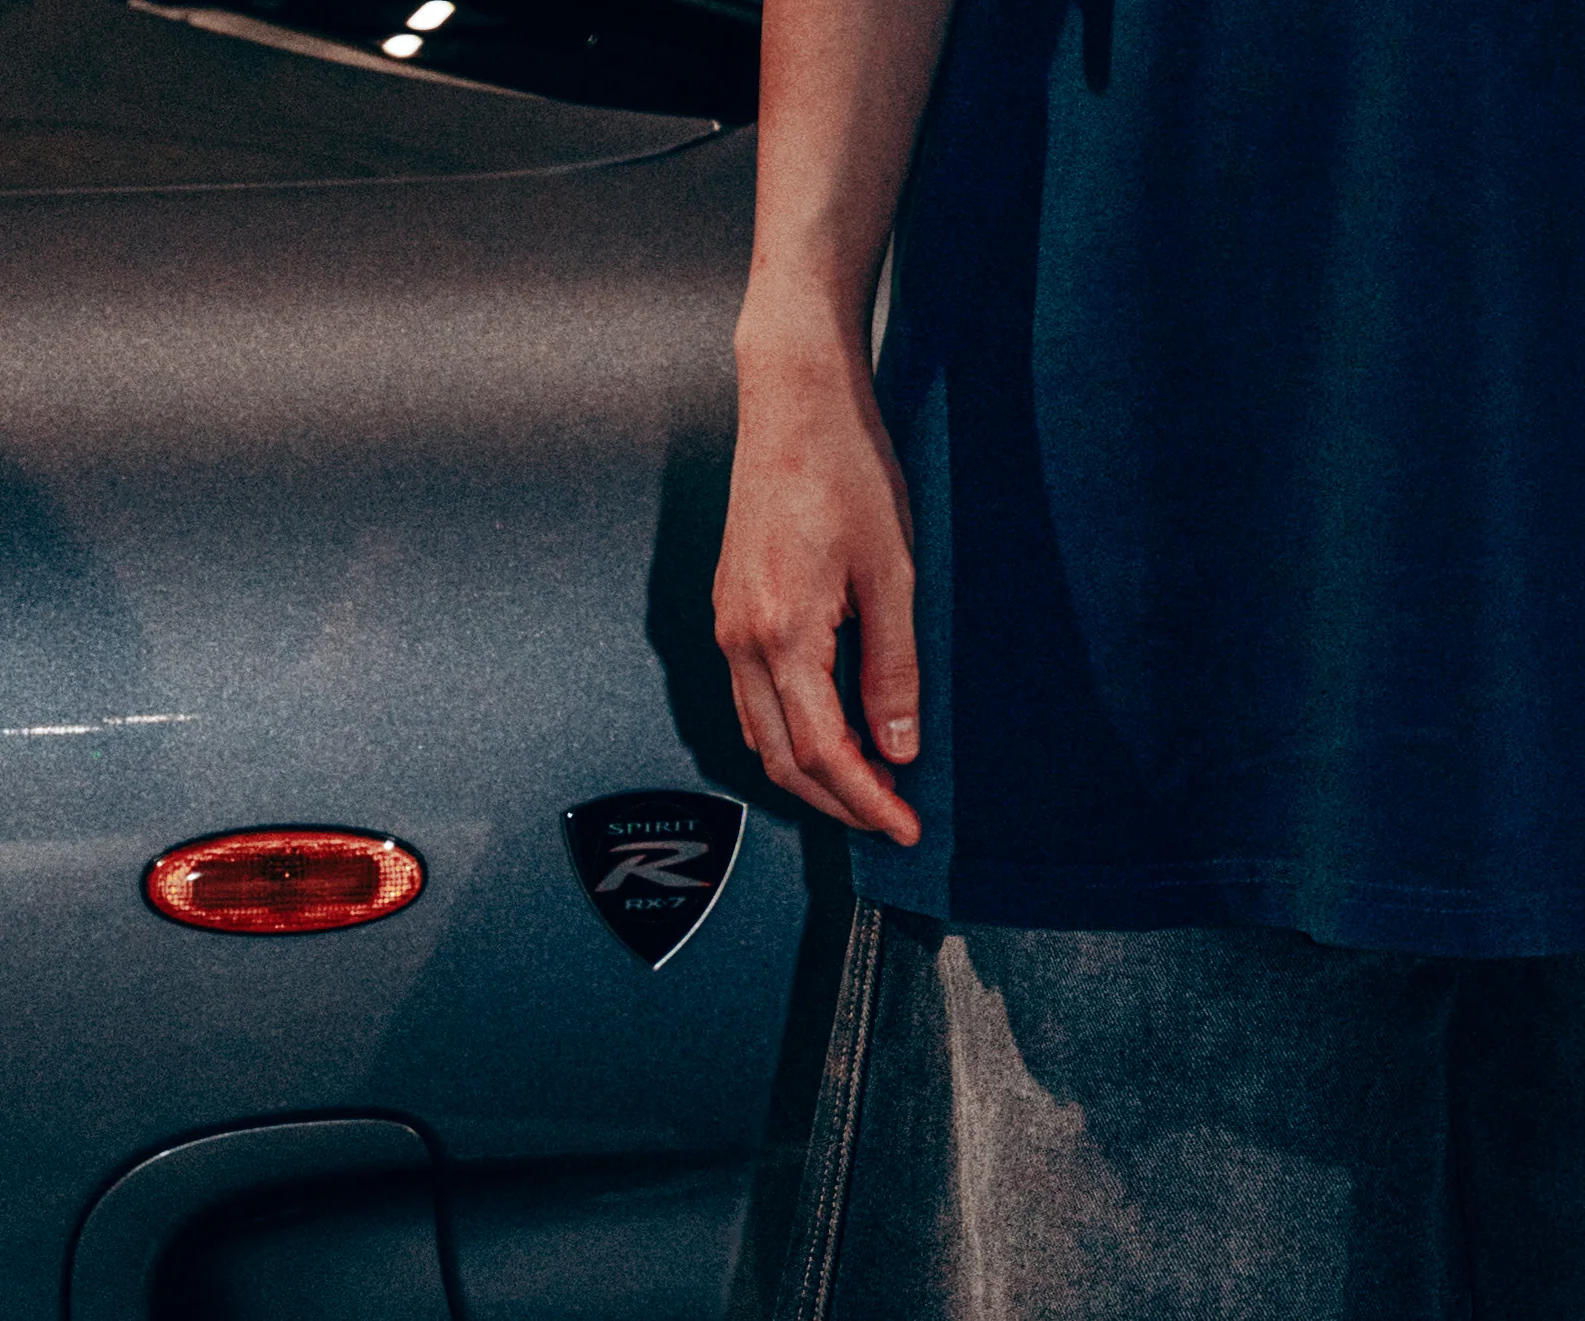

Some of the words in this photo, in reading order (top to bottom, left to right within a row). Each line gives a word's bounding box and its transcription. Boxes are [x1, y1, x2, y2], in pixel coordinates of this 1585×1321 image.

[608, 820, 698, 835] SPIRIT
[595, 840, 712, 892] R
[625, 896, 686, 910] RX-7
